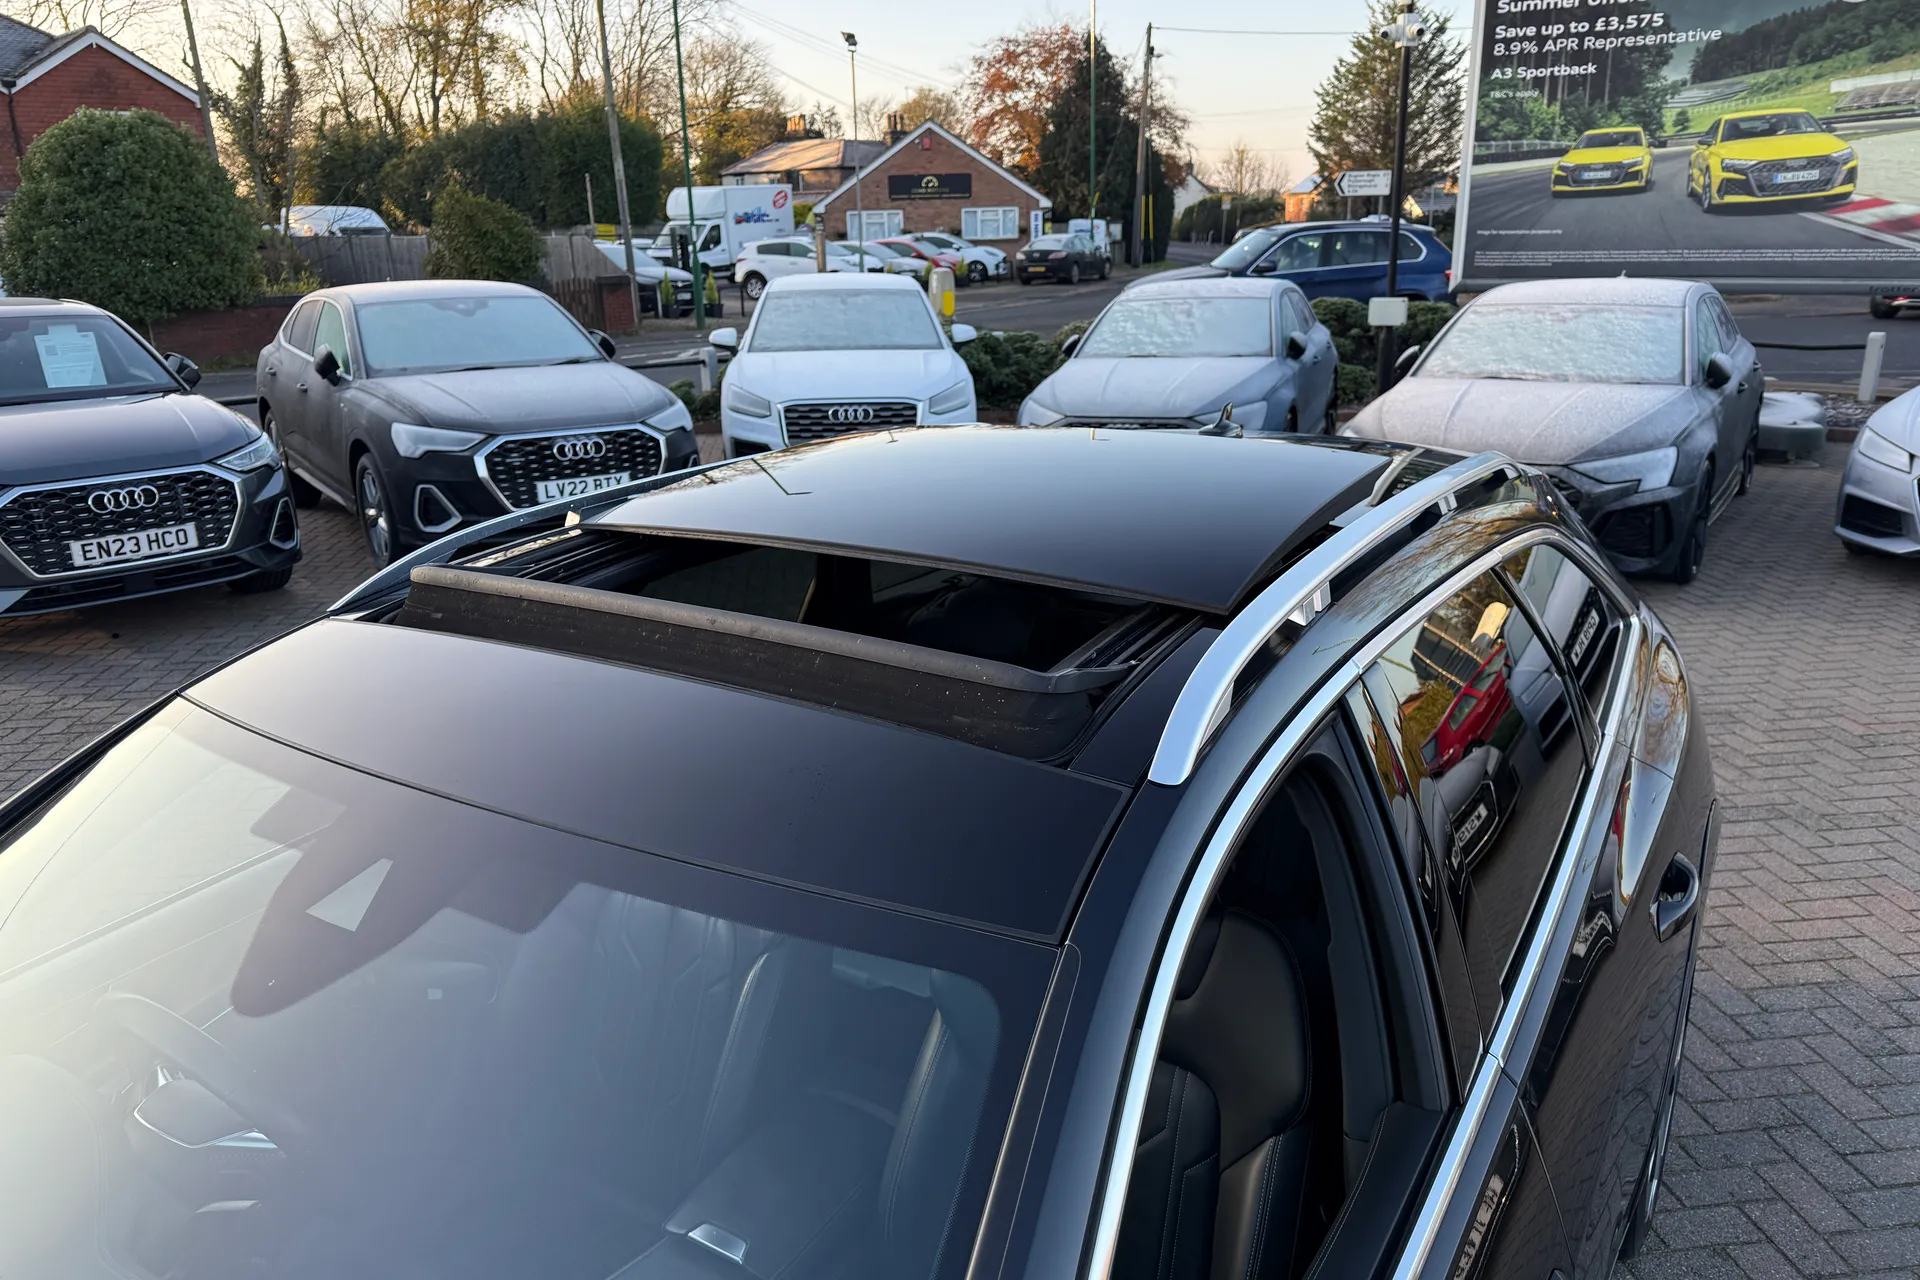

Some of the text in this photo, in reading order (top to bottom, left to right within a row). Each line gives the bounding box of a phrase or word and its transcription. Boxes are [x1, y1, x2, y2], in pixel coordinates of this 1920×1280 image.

[1497, 0, 1579, 14] Summer
[1495, 12, 1665, 39] Save up to £3,575
[1493, 28, 1722, 56] 8.9% APR Representative
[1490, 62, 1597, 80] A3 Sportback
[544, 480, 588, 499] LV22
[80, 528, 189, 561] EN23 HCO
